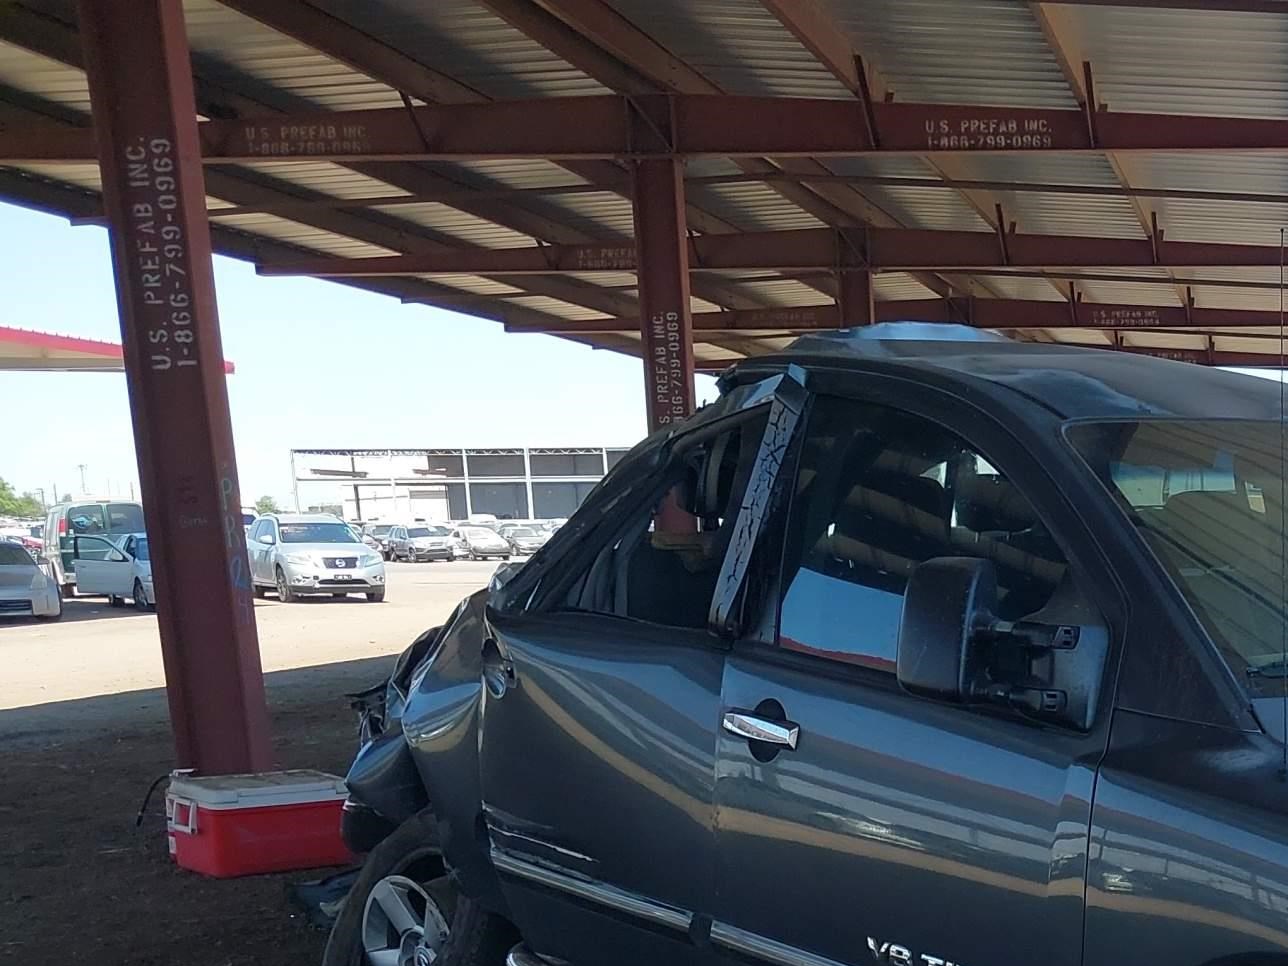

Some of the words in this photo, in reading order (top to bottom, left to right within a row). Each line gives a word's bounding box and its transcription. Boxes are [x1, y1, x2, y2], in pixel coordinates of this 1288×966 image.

[280, 126, 337, 140] PREFAB
[925, 119, 953, 133] U.S.
[960, 119, 1017, 133] PREFAB
[1024, 118, 1052, 133] INC.
[126, 136, 149, 188] INC.
[133, 203, 164, 304] PREFAB
[151, 138, 198, 367] 1-866-799-0969
[149, 321, 172, 370] U.S.
[652, 311, 666, 339] INC.
[655, 346, 670, 403] PREFAB
[666, 311, 685, 424] 66-799-0969
